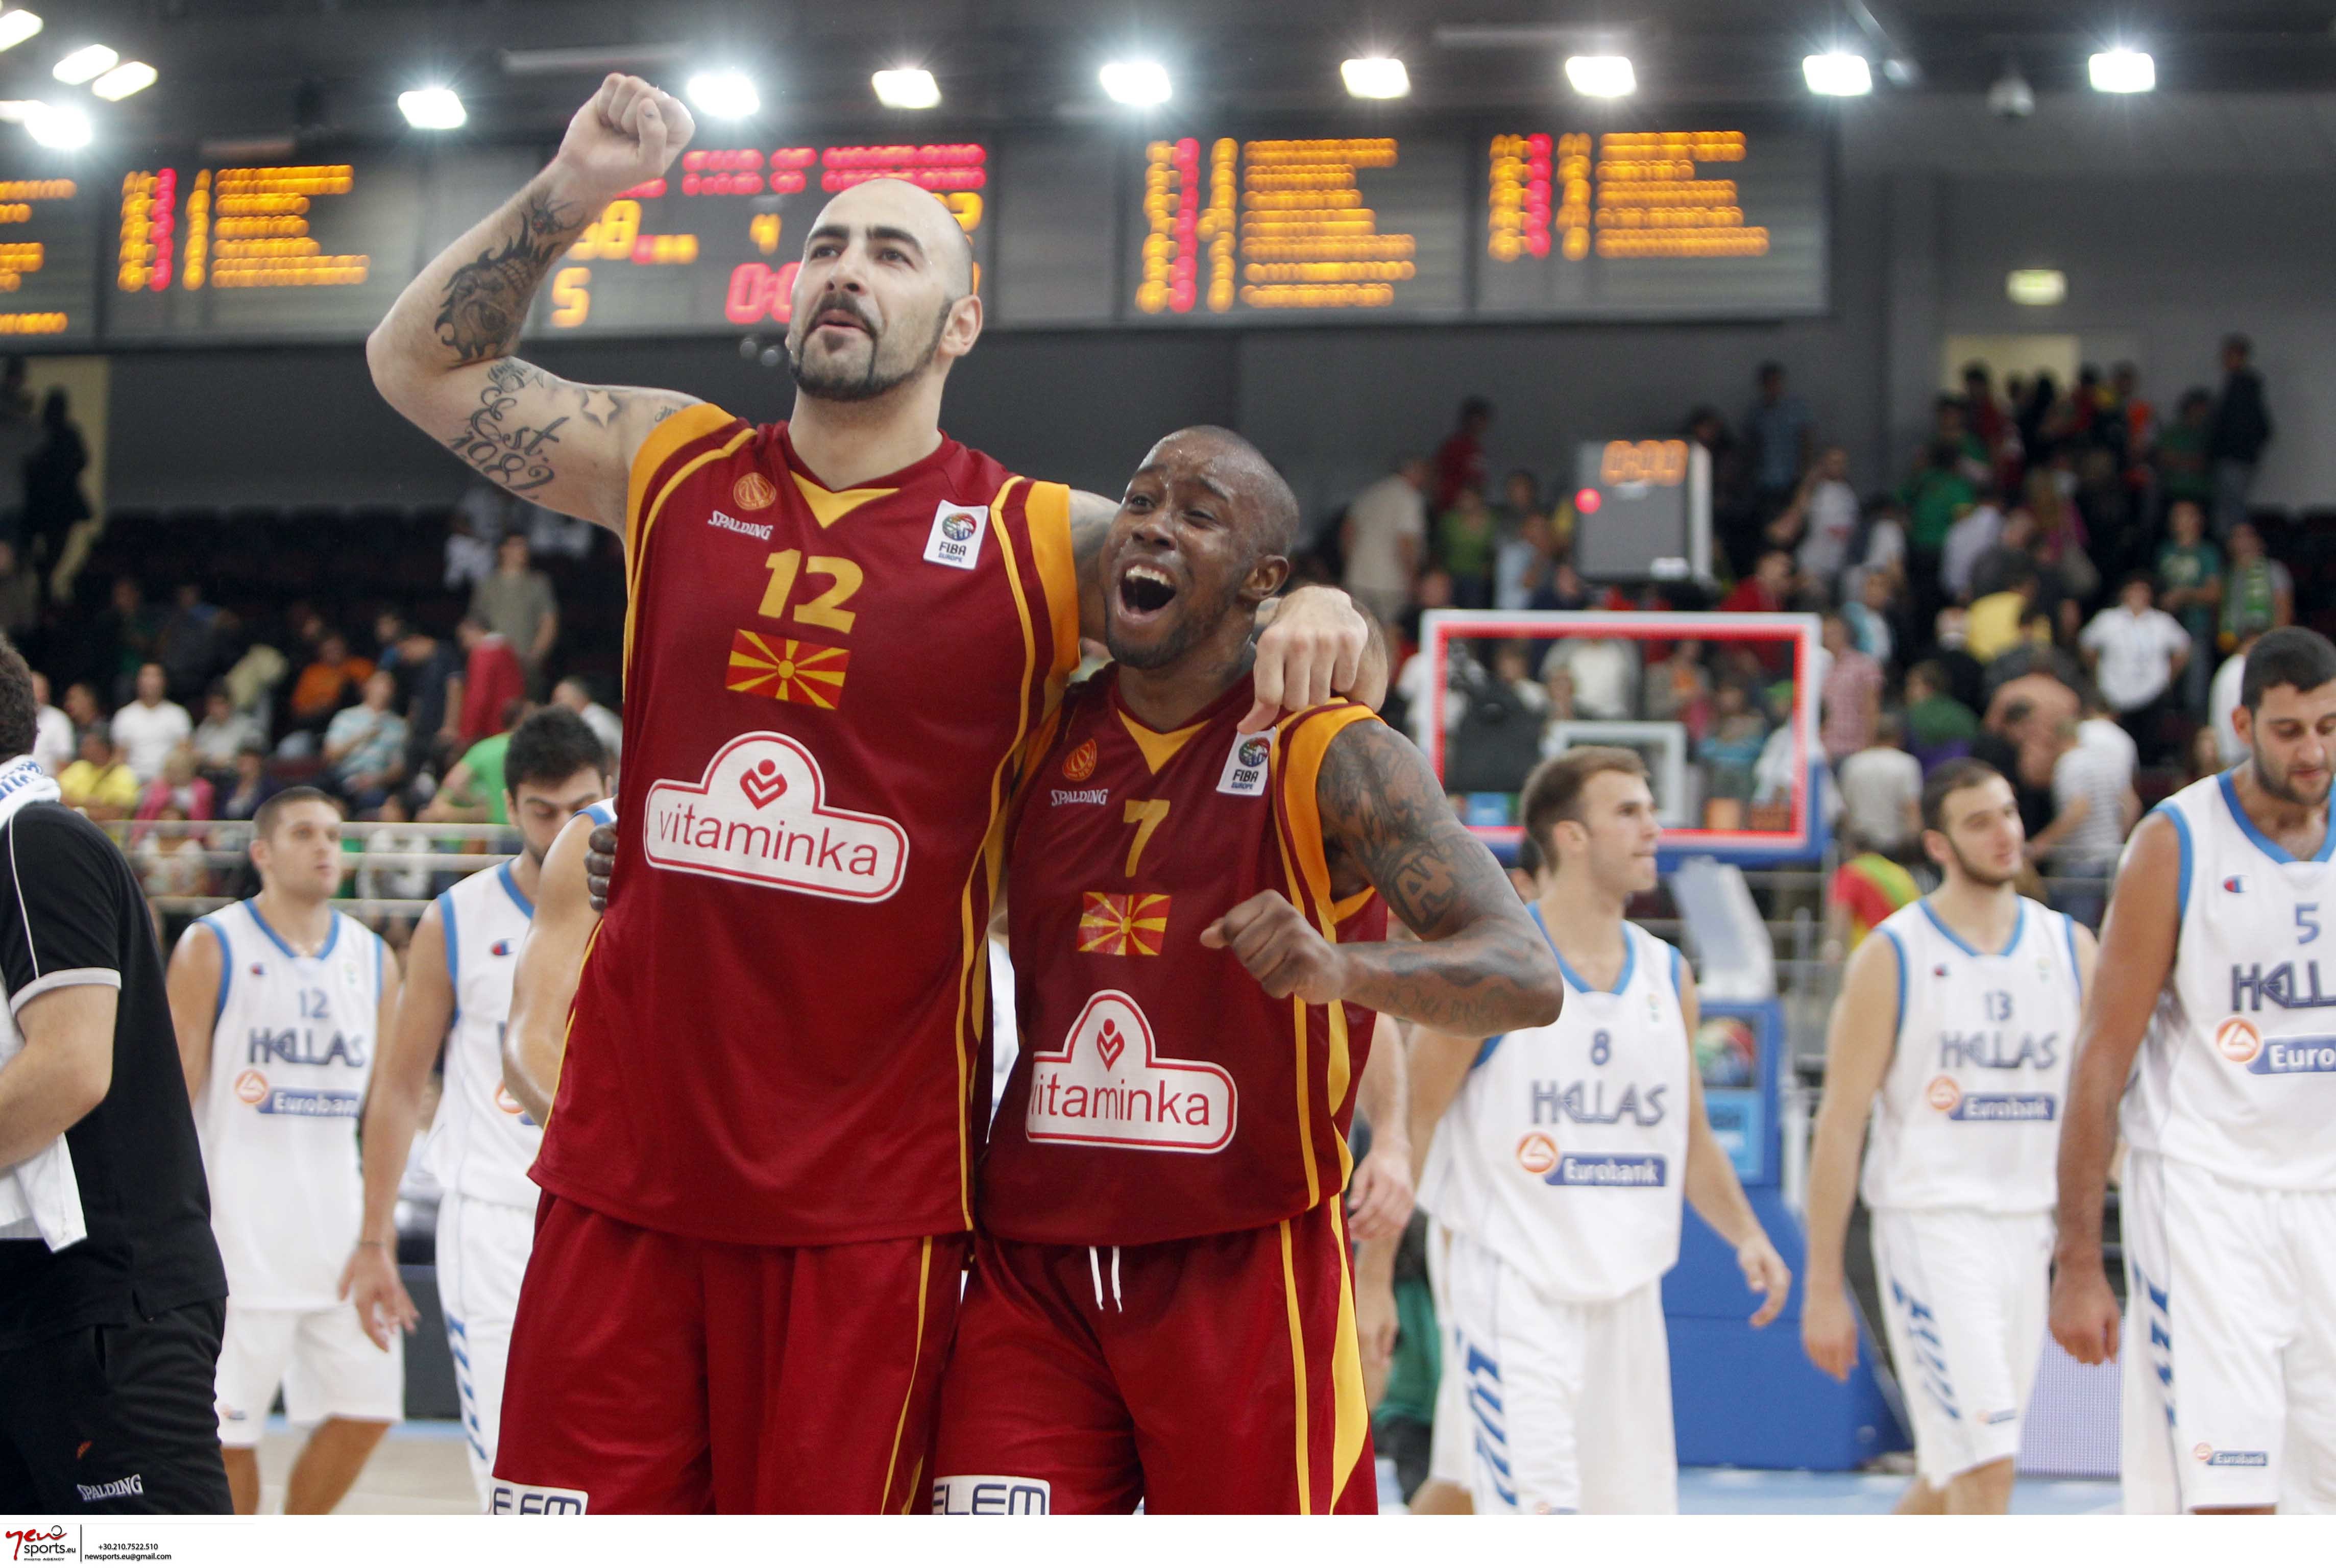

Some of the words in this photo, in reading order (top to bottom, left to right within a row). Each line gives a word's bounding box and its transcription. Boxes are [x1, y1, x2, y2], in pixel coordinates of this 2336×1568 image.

[708, 510, 773, 541] SPALDING
[939, 541, 967, 556] FIBA
[758, 548, 863, 634] 12
[1233, 769, 1259, 782] FIBA
[1052, 789, 1108, 806] SPALDING
[660, 803, 878, 876] vitaminka
[1124, 799, 1171, 877] 7
[2295, 902, 2321, 945] 5
[298, 987, 329, 1018] 12
[1985, 990, 2013, 1021] 13
[248, 1028, 366, 1068] HELLAS
[1591, 1029, 1611, 1066] 8
[1939, 1031, 2059, 1070] HELLAS
[2268, 1044, 2336, 1068] Euro
[273, 1091, 359, 1113] Euroban
[1530, 1080, 1668, 1127] HELLAS
[1564, 1157, 1659, 1181] Eurobank
[77, 1474, 144, 1503] SPALDING
